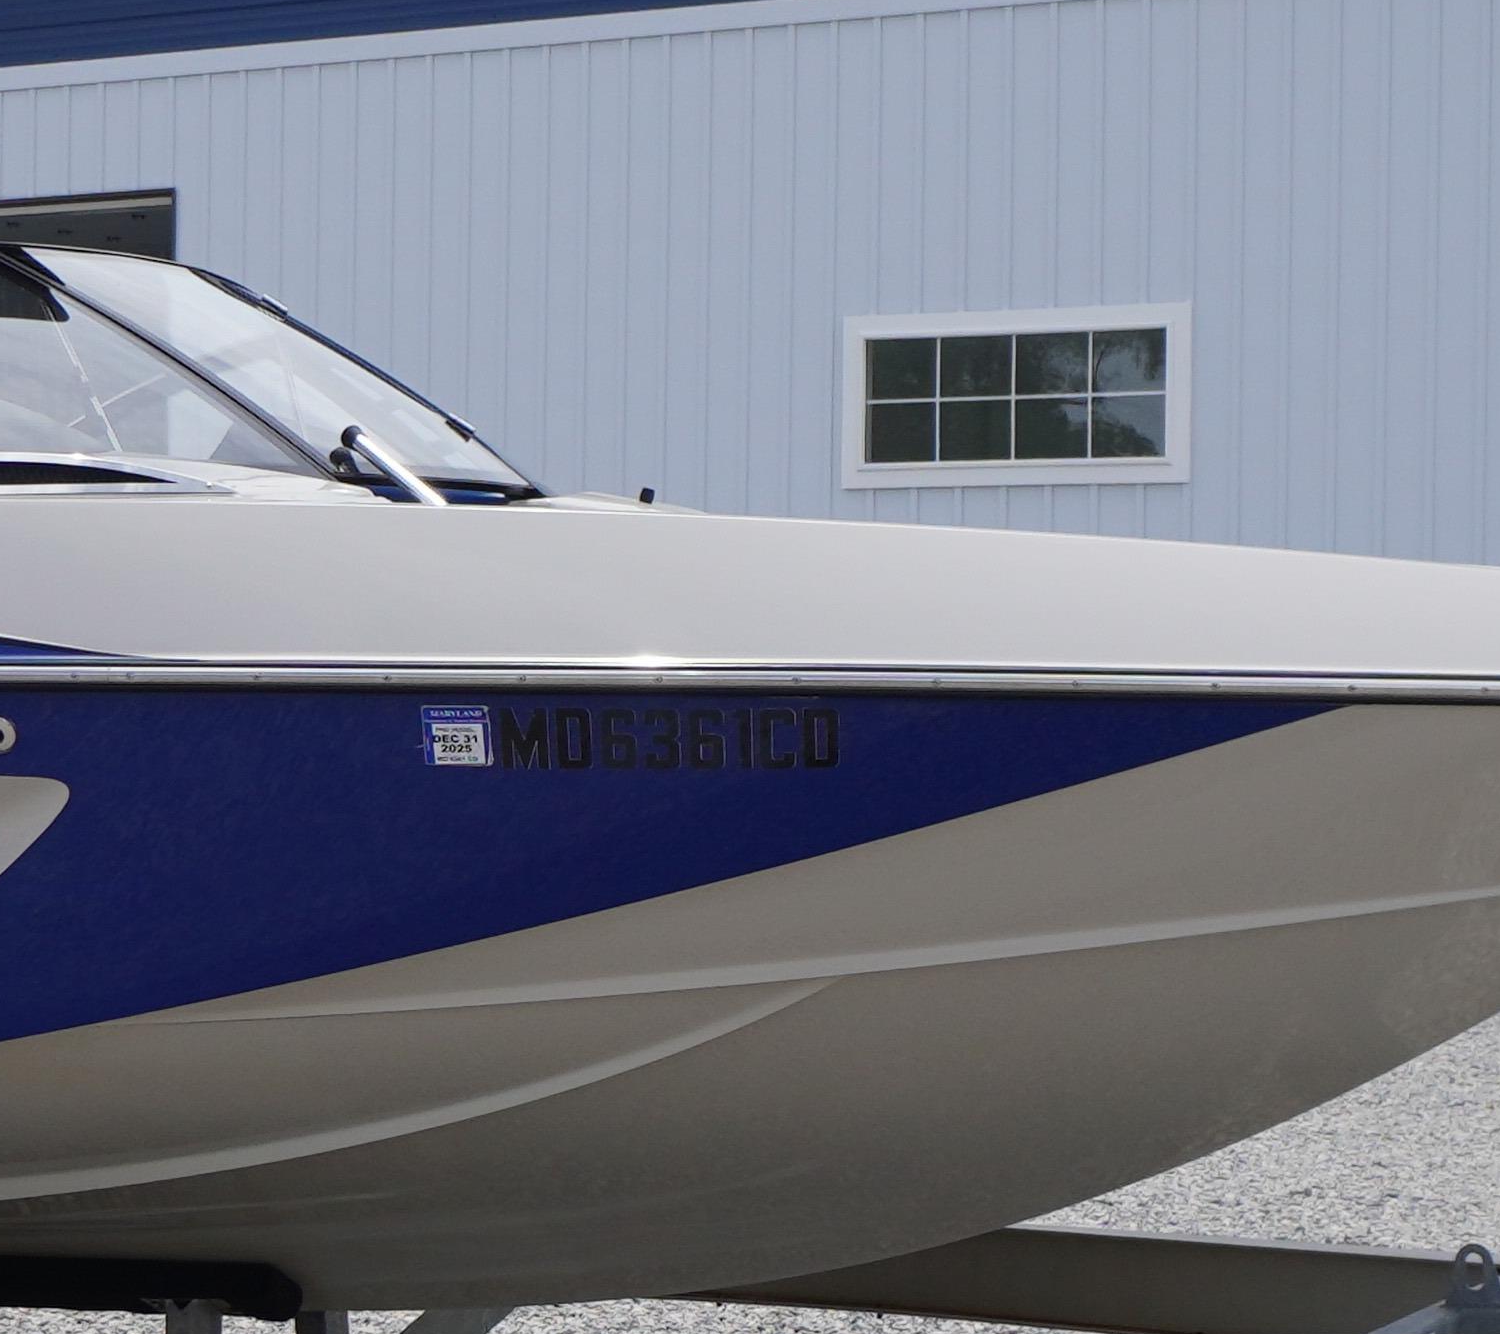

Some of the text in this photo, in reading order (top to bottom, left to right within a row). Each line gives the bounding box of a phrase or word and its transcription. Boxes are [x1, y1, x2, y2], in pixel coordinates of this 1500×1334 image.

[433, 734, 478, 744] DEC 31
[441, 743, 473, 754] 2025
